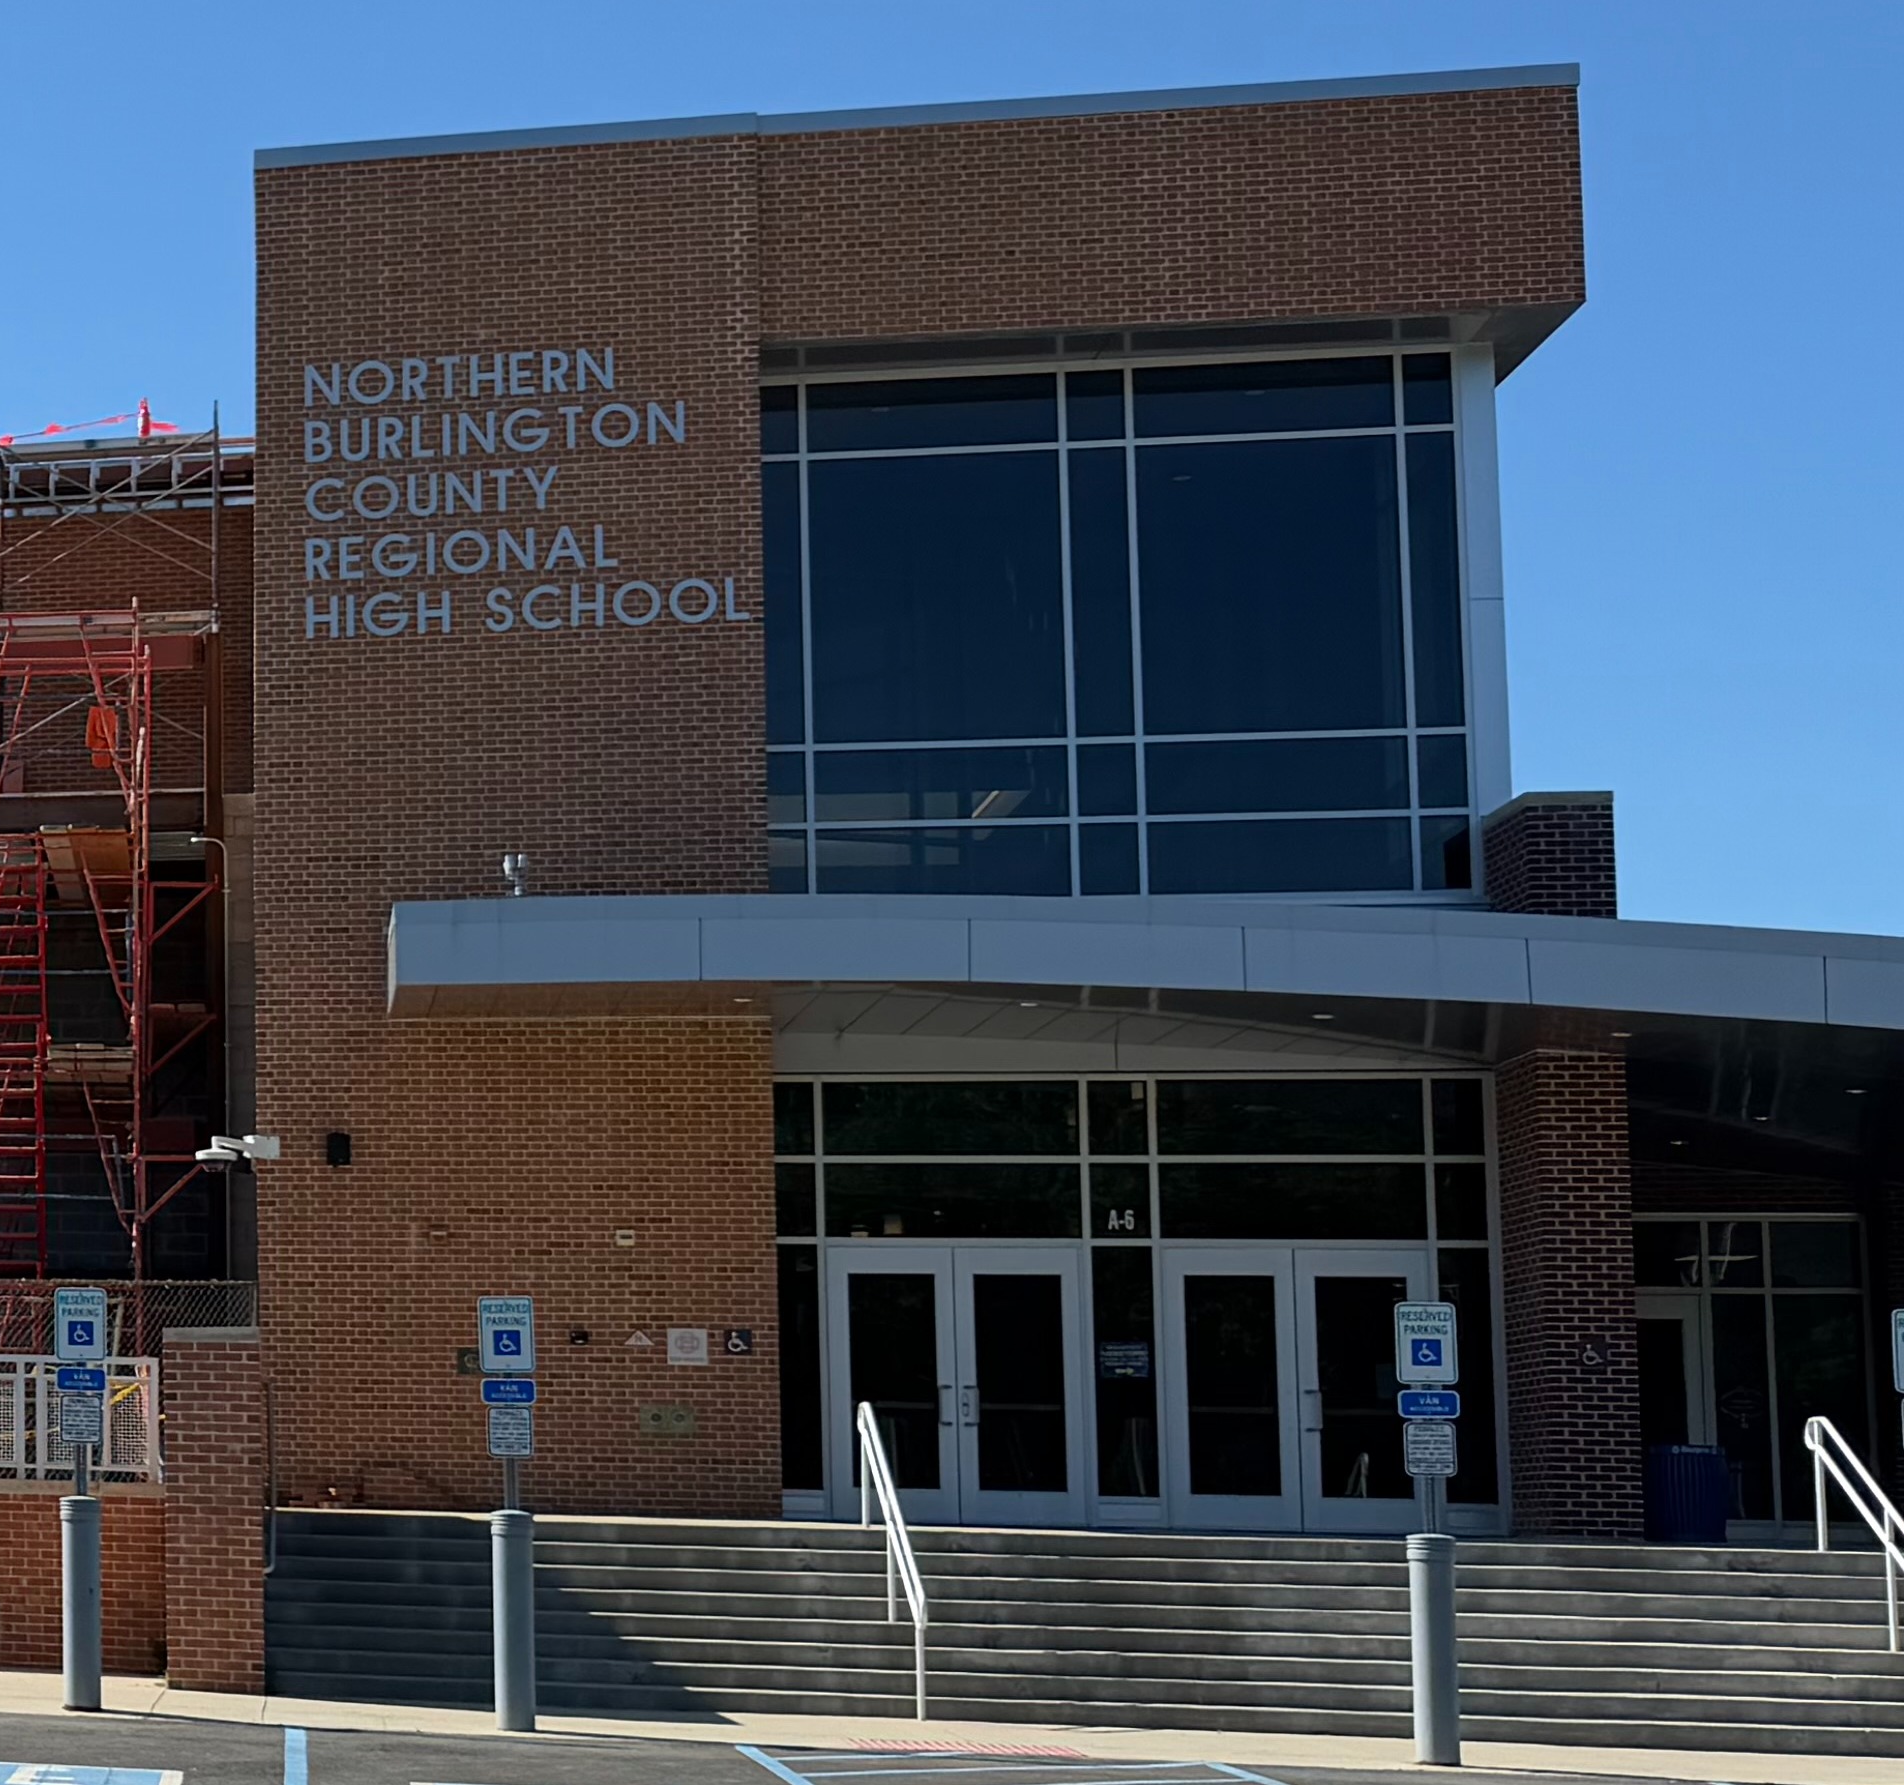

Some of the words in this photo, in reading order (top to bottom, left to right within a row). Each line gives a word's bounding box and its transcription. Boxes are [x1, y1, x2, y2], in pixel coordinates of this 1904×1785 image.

[304, 347, 614, 407] NORTHERN
[304, 401, 686, 464] BURLINGTON
[305, 466, 559, 522] COUNTY
[304, 525, 618, 581] REGIONAL
[305, 591, 452, 640] HIGH
[485, 577, 751, 633] SCHOOL
[1107, 1209, 1135, 1230] A-6
[61, 1307, 100, 1318] PARKING
[485, 1316, 528, 1327] PARKING
[1403, 1324, 1449, 1336] PARKING
[1418, 1396, 1440, 1405] VAN
